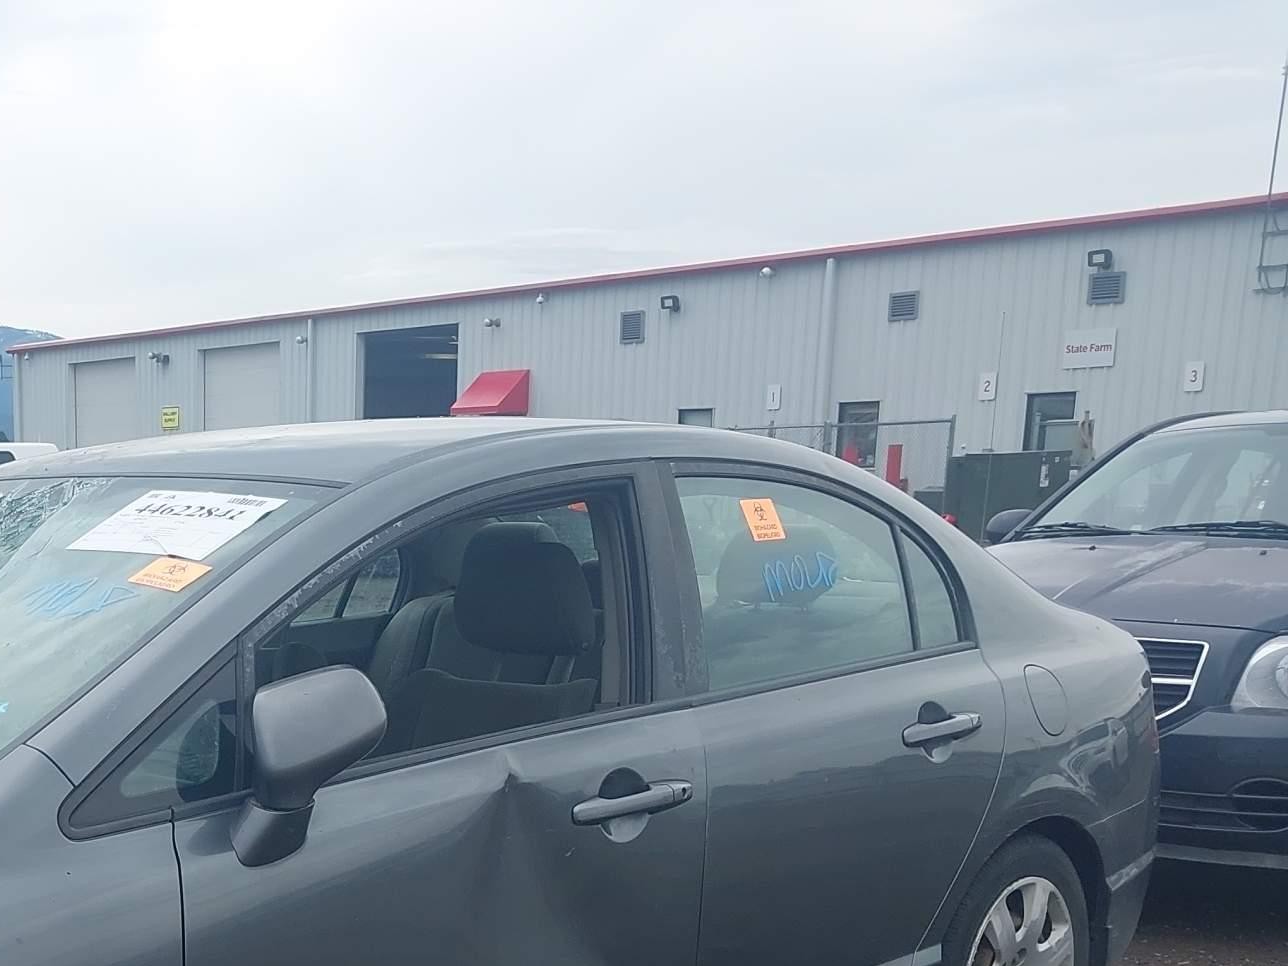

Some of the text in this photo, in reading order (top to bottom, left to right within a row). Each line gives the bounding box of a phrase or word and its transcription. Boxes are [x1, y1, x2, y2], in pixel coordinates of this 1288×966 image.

[1065, 343, 1112, 353] State Farm
[1190, 369, 1198, 383] 3
[984, 380, 991, 392] 2
[135, 503, 247, 520] 44622841
